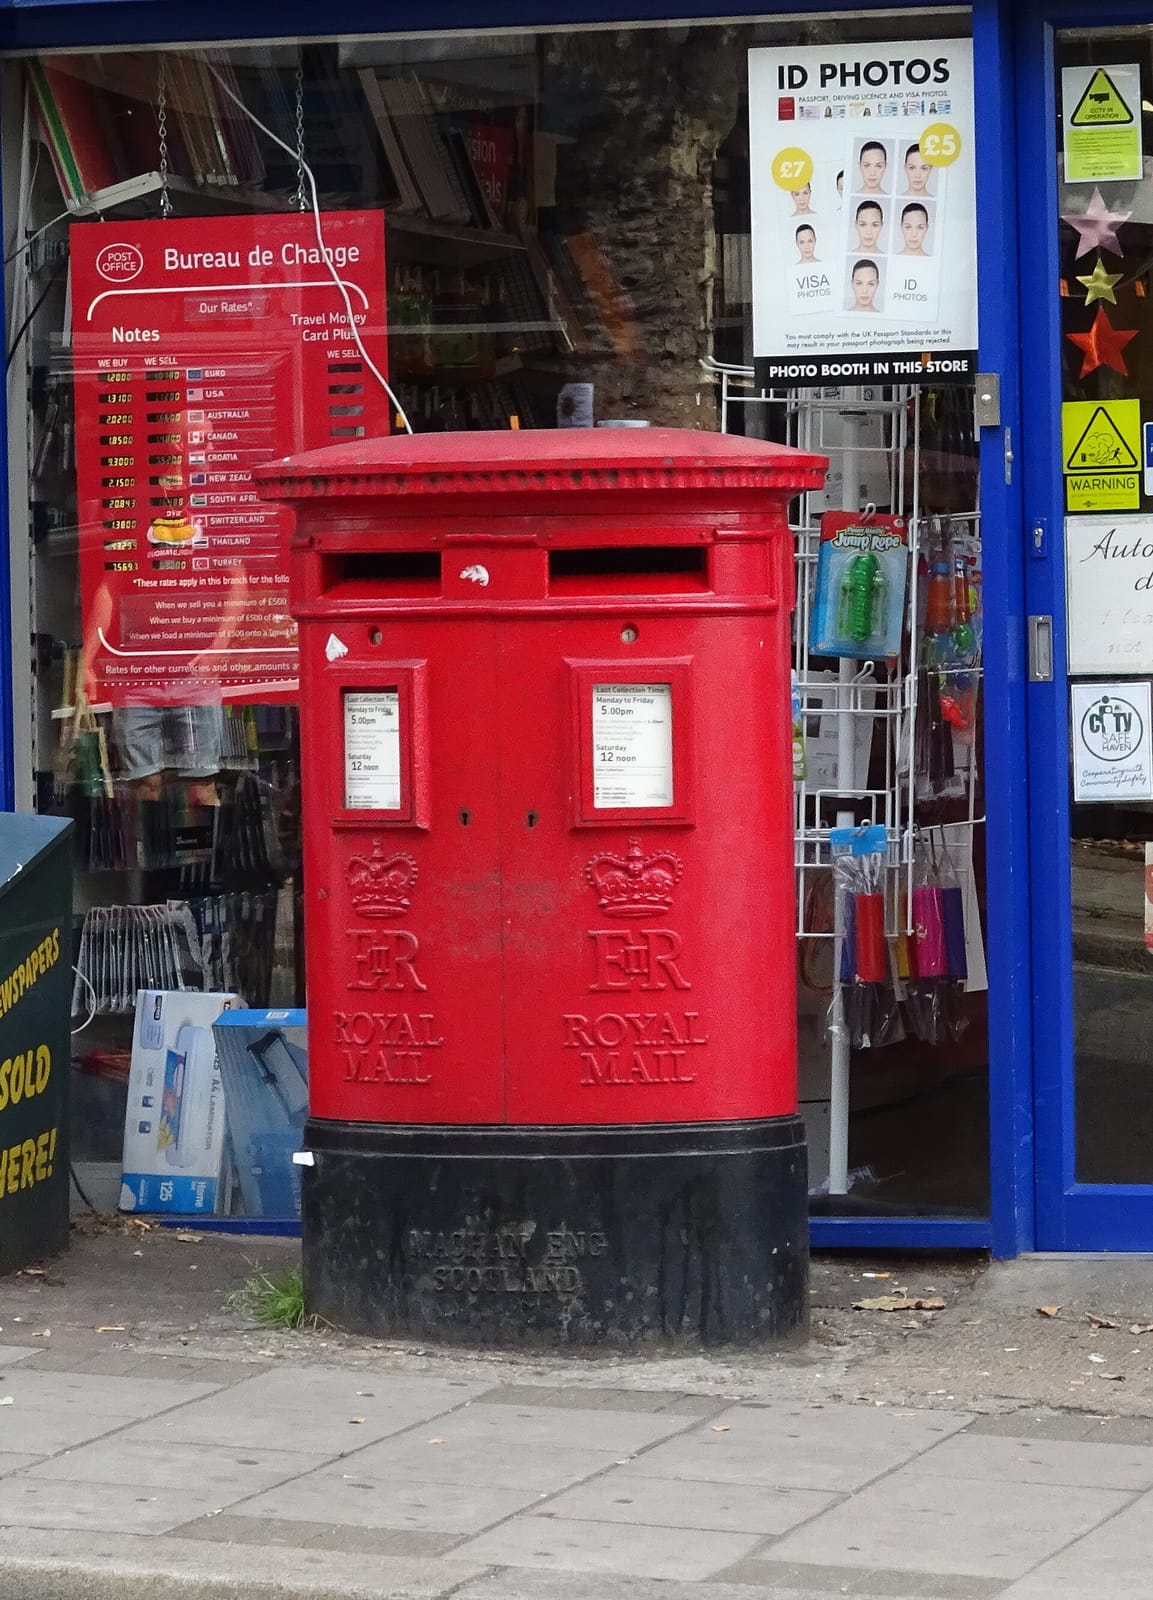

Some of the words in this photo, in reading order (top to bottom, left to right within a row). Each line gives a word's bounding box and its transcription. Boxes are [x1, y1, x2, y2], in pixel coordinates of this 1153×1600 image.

[778, 65, 808, 90] ID
[820, 58, 950, 88] PHOTOS
[833, 94, 860, 102] DRIVING
[861, 92, 887, 100] LICENCE
[924, 134, 956, 156] £5
[780, 160, 805, 178] £7
[108, 252, 132, 261] POST
[165, 248, 240, 270] Bureau
[248, 248, 273, 267] de
[282, 243, 360, 267] Change
[102, 261, 136, 272] OFFICE
[796, 274, 830, 290] VISA
[904, 279, 917, 291] ID
[797, 288, 832, 299] PHOTOS
[893, 292, 928, 302] PHOTOS
[199, 303, 218, 314] Our
[290, 313, 326, 327] Travel
[329, 312, 367, 327] Money
[112, 326, 160, 343] Notes
[302, 329, 328, 342] Card
[333, 328, 358, 341] Plus
[785, 333, 797, 341] You
[813, 333, 835, 342] comply
[837, 331, 849, 339] with
[862, 330, 872, 338] UK
[873, 330, 899, 339] Passport
[900, 328, 931, 337] Standards
[826, 341, 840, 349] your
[841, 340, 868, 348] passport
[869, 338, 905, 347] photograph
[906, 337, 924, 346] being
[925, 336, 950, 345] rejected
[327, 350, 340, 359] WE
[342, 349, 361, 358] SELL
[98, 359, 112, 367] WE
[112, 359, 128, 367] BUY
[144, 357, 157, 366] WE
[159, 356, 178, 365] SELL
[204, 369, 226, 378] EURO
[769, 364, 818, 378] PHOTO
[821, 362, 870, 376] BOOTH
[874, 361, 889, 375] IN
[892, 361, 923, 374] THIS
[926, 360, 969, 373] STORE
[205, 390, 224, 398] USA
[207, 410, 250, 419] AUSTRALIA
[207, 432, 238, 440] CANADA
[207, 453, 238, 462] CROATIA
[209, 474, 226, 483] NEW
[1070, 477, 1136, 491] WARNING
[209, 495, 236, 504] SOUTH
[210, 515, 265, 525] SWITZERLAND
[212, 537, 251, 546] THAILAND
[834, 534, 870, 550] Jump
[872, 535, 900, 551] Rope
[213, 557, 242, 567] TURKEY
[159, 578, 178, 587] rates
[178, 577, 198, 588] apply
[200, 576, 206, 585] in
[208, 576, 221, 585] this
[223, 575, 246, 585] branch
[248, 575, 260, 584] for
[261, 574, 274, 583] the
[155, 600, 176, 610] When
[177, 601, 188, 609] we
[189, 600, 201, 609] sell
[202, 600, 216, 609] you
[223, 598, 257, 607] minimum
[258, 597, 267, 607] of
[150, 616, 171, 625] When
[171, 616, 182, 624] we
[182, 616, 196, 625] buy
[202, 615, 237, 623] minimum
[237, 614, 245, 622] of
[129, 631, 150, 641] When
[151, 632, 162, 640] we
[162, 631, 177, 640] load
[184, 630, 217, 639] minimum
[218, 629, 226, 638] of
[105, 664, 128, 674] Rates
[130, 664, 142, 673] for
[144, 663, 167, 673] other
[168, 663, 209, 673] currencies
[212, 662, 228, 672] and
[230, 662, 252, 672] other
[254, 661, 290, 672] amounts
[612, 686, 646, 694] Collection
[647, 686, 665, 694] Time
[347, 695, 359, 703] Last
[359, 695, 385, 703] Collection
[596, 697, 622, 705] Monday
[632, 697, 654, 705] Friday
[375, 705, 391, 713] Friday
[601, 705, 634, 717] 5.00pm
[351, 715, 377, 726] 5.00pm
[1102, 733, 1131, 744] SAFE
[596, 744, 627, 752] Saturday
[1103, 744, 1132, 752] HAVEN
[348, 752, 372, 761] Saturday
[600, 752, 614, 762] 12
[352, 761, 362, 771] 12
[333, 1011, 444, 1047] ROYAL
[562, 1011, 709, 1047] ROYAL
[343, 1050, 432, 1085] MAIL
[580, 1050, 697, 1086] MAIL
[159, 1181, 173, 1202] 125
[433, 1265, 583, 1293] SCOTLAND
